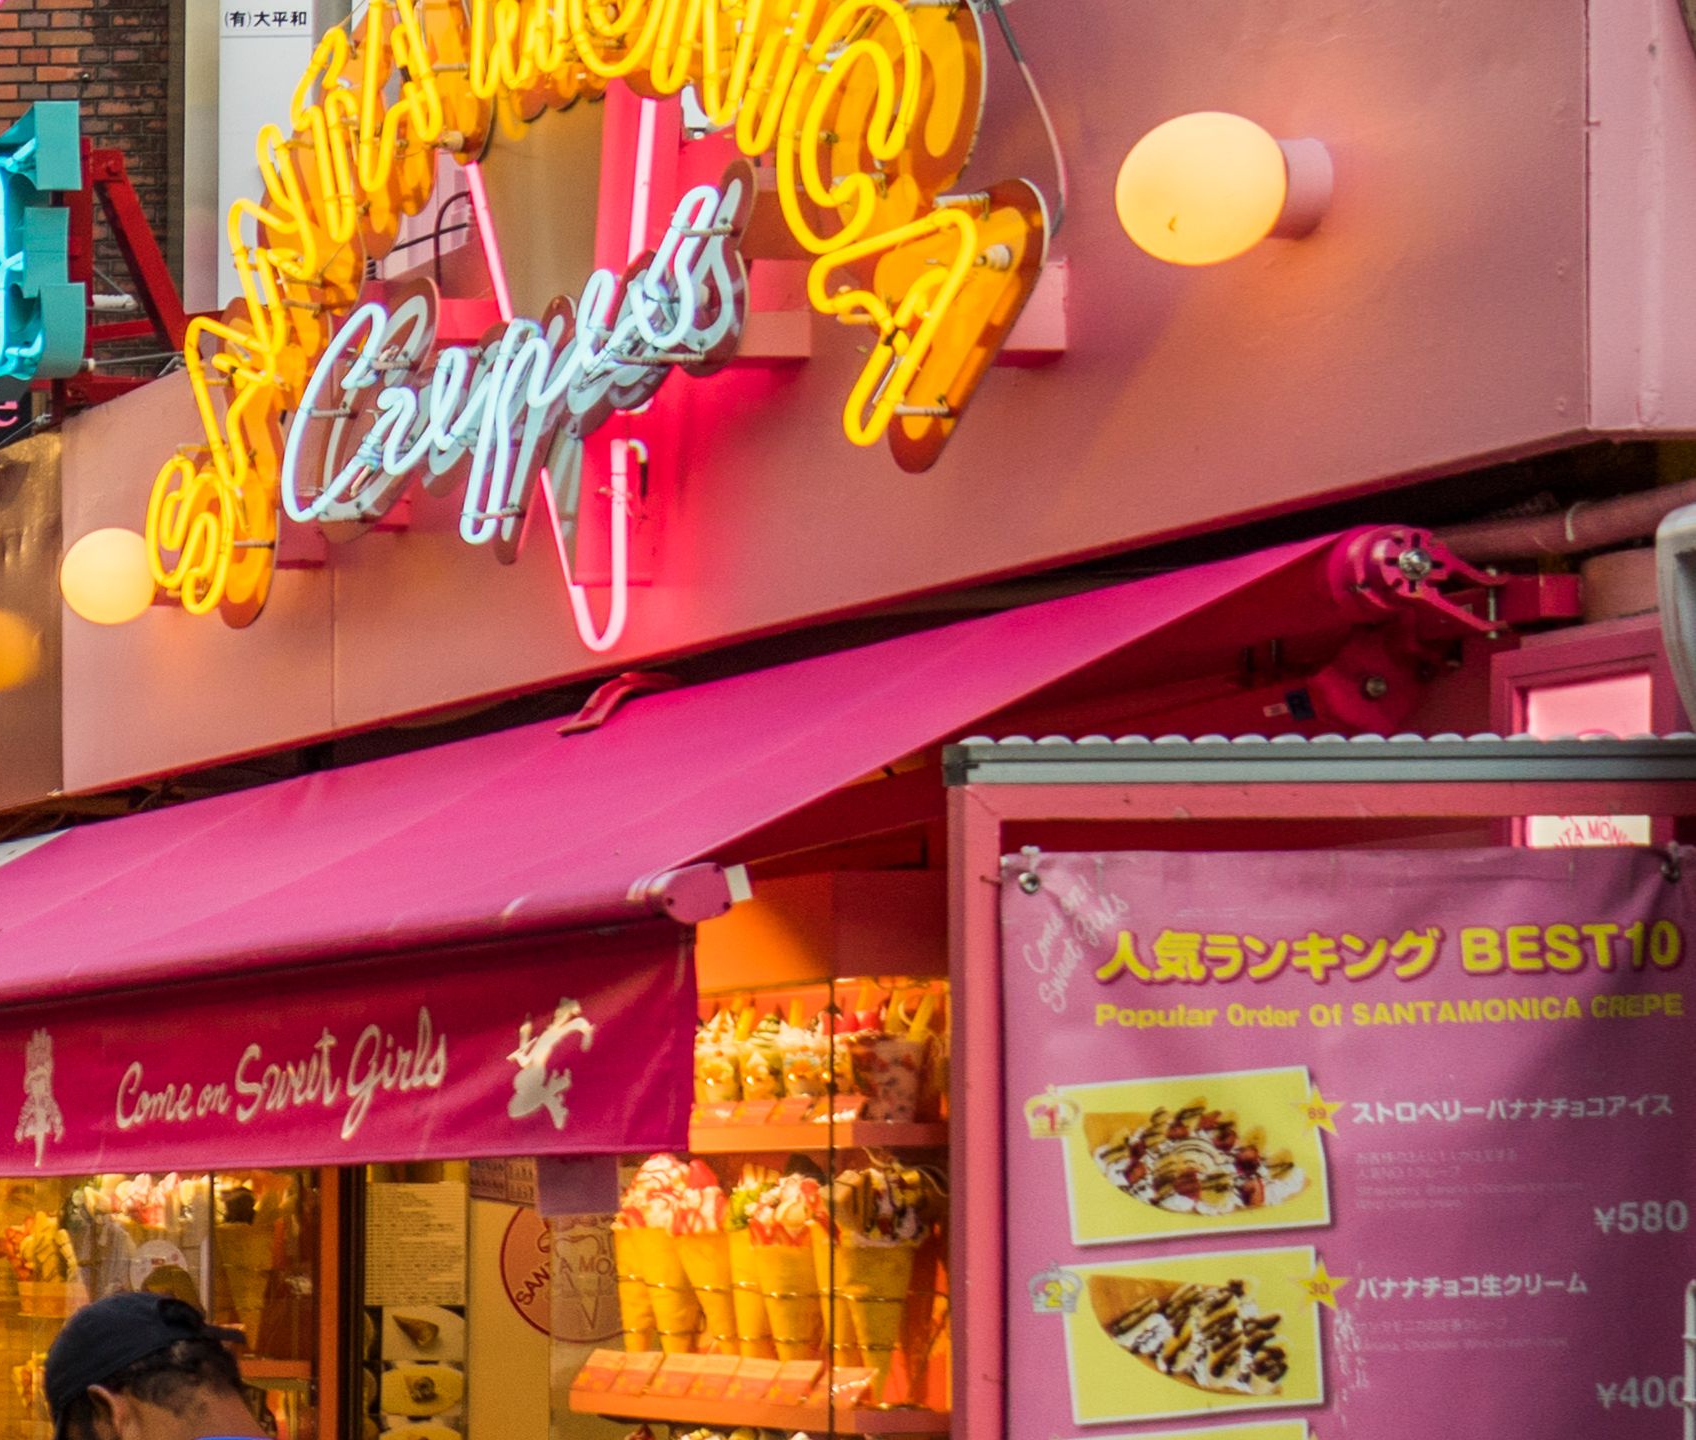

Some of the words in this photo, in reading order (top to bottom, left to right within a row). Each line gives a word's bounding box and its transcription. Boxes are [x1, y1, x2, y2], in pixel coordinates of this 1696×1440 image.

[1095, 927, 1441, 982] 人気ランキング
[1095, 1003, 1217, 1030] Popular
[1226, 1004, 1300, 1027] Order
[1590, 993, 1684, 1019] CREPE
[1352, 1095, 1674, 1126] ストロベリーバナナチョコアイス
[1593, 1201, 1689, 1234] ¥580
[1356, 1271, 1588, 1302] バナナチョコ生クリーム
